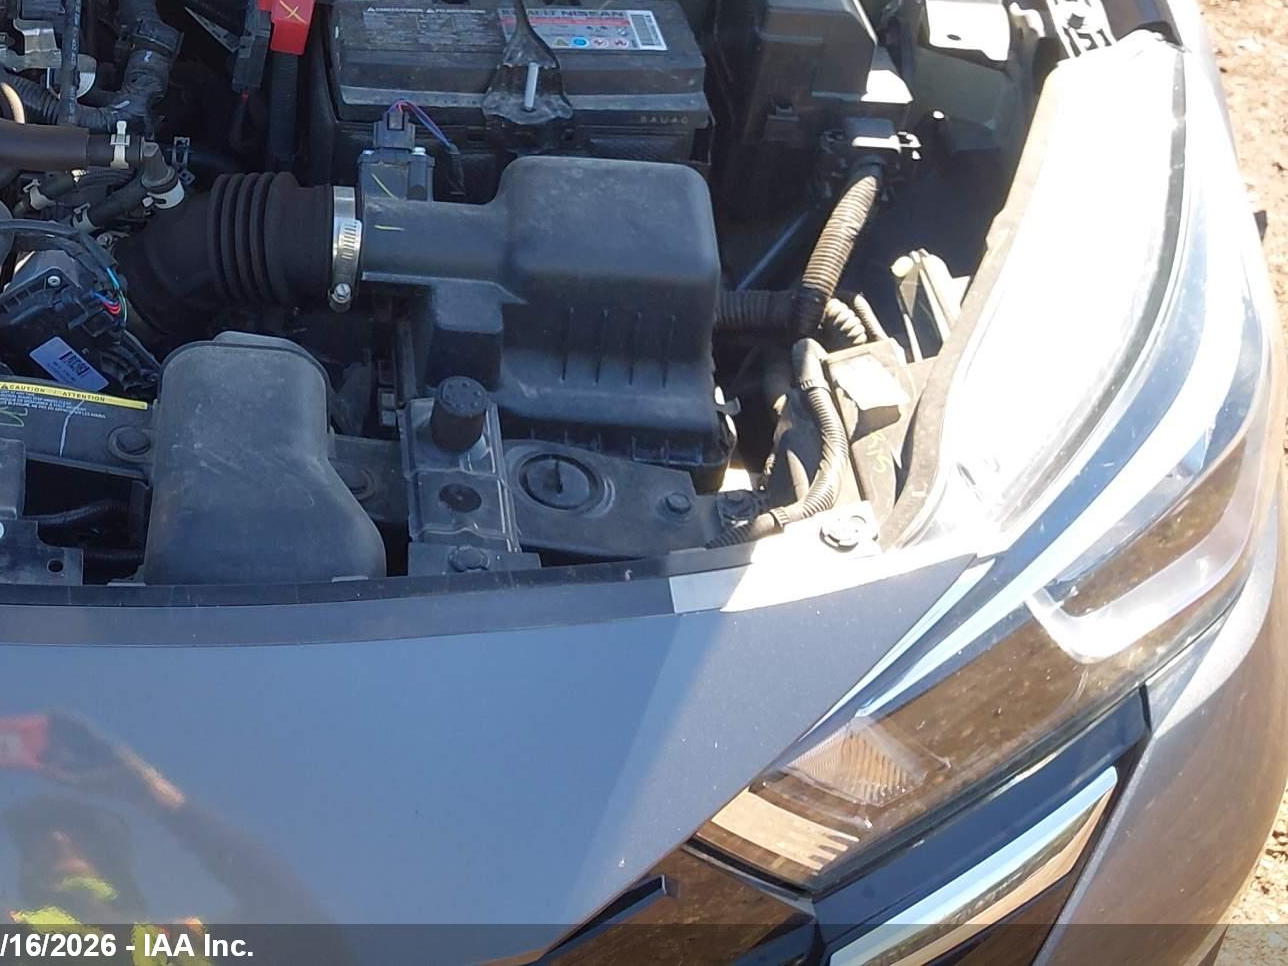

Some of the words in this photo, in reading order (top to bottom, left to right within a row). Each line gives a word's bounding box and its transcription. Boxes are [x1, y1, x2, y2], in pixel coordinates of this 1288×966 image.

[560, 9, 625, 18] NISSAN
[9, 384, 46, 393] CAUTION
[62, 391, 106, 402] ATTENTION
